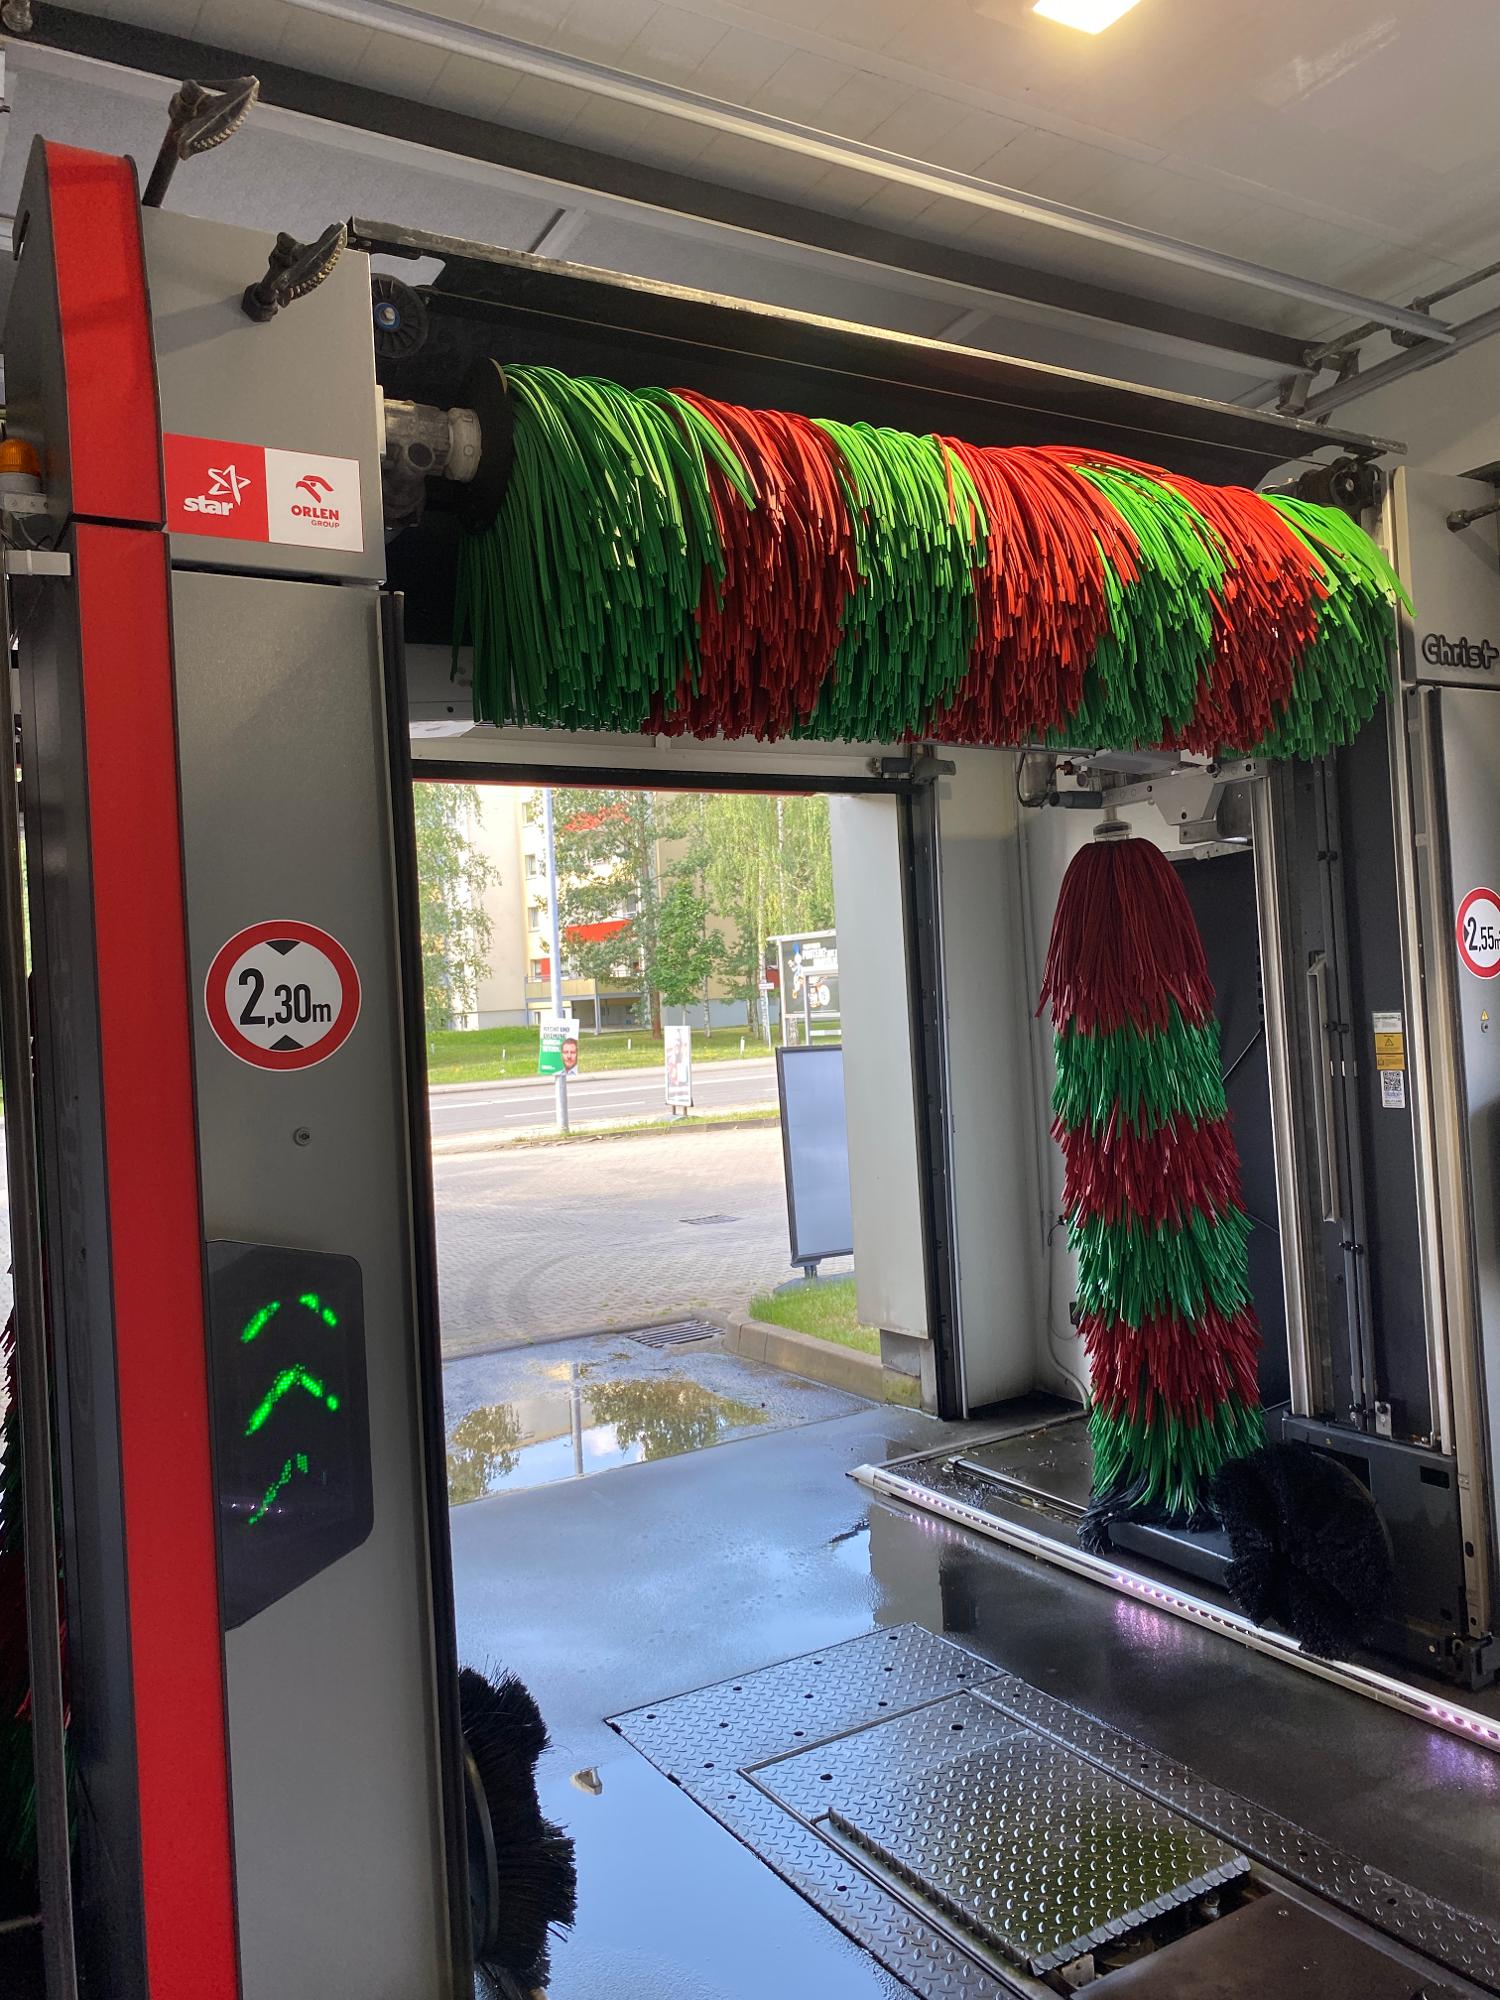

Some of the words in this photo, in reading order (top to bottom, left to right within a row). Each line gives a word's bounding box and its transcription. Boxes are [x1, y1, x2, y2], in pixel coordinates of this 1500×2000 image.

[183, 495, 234, 516] star
[291, 505, 339, 520] ORLEN
[311, 519, 340, 528] GROUP
[1422, 633, 1499, 670] Christ
[238, 968, 332, 1028] 2,30m
